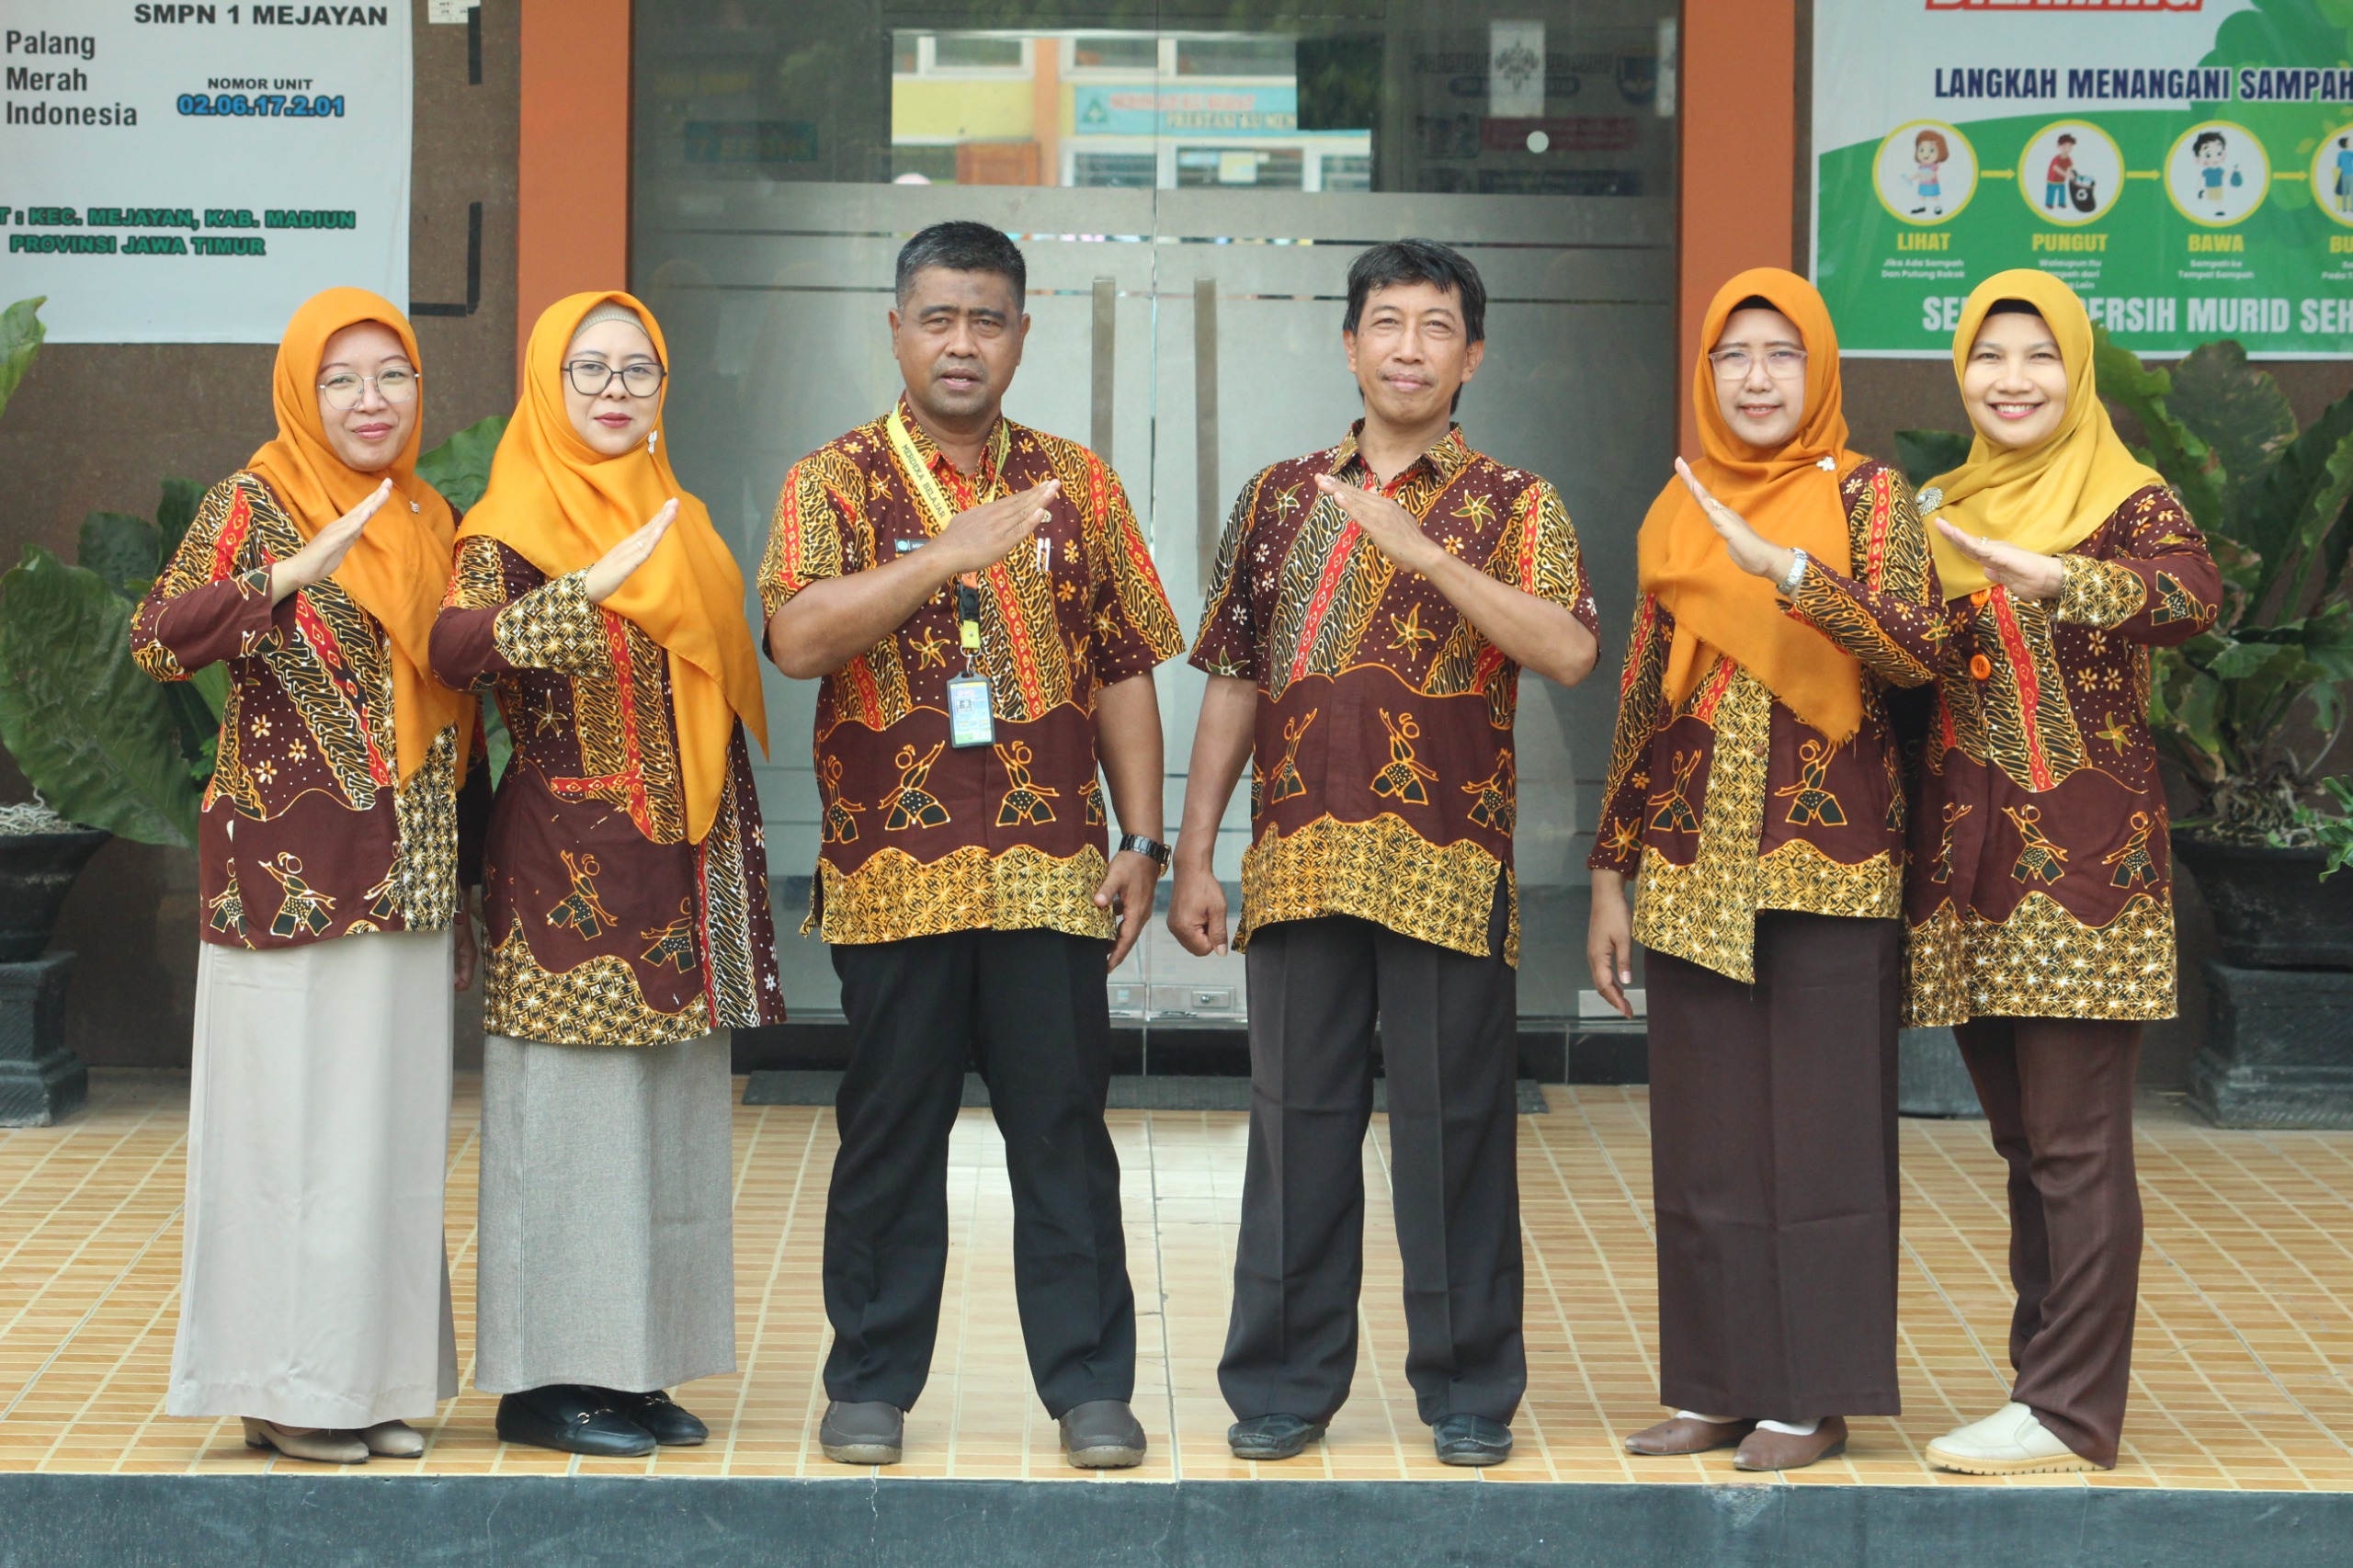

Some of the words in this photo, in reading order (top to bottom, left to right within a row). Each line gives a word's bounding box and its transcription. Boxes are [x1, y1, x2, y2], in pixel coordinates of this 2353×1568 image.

[134, 5, 216, 24] SMPN
[227, 6, 240, 24] 1
[253, 6, 388, 26] MEJAYAN
[6, 29, 96, 61] Palang
[6, 66, 88, 91] Merah
[208, 78, 268, 90] NOMOR
[274, 78, 313, 90] UNIT
[1935, 68, 2058, 98] LANGKAH
[2068, 68, 2230, 99] MENANGANI
[2240, 69, 2353, 100] SAMPAH
[6, 100, 138, 126] Indonesia
[176, 94, 345, 117] 02.06.17.2.01
[28, 207, 84, 226] KEC.
[87, 208, 200, 231] MEJAYAN,
[204, 210, 261, 228] KAB.
[265, 210, 356, 229] MADIUN
[9, 234, 117, 254] PROVINSI
[120, 235, 188, 255] JAWA
[190, 236, 267, 256] TIMUR
[1897, 233, 1951, 251] LIHAT
[2031, 233, 2109, 252] PUNGUT
[2188, 234, 2245, 252] BAWA
[1926, 258, 1964, 269] Sampah
[2187, 298, 2290, 333] MURID
[2300, 298, 2353, 334] SEH
[902, 444, 925, 482] MERDEKA
[923, 483, 946, 519] BELAJAR
